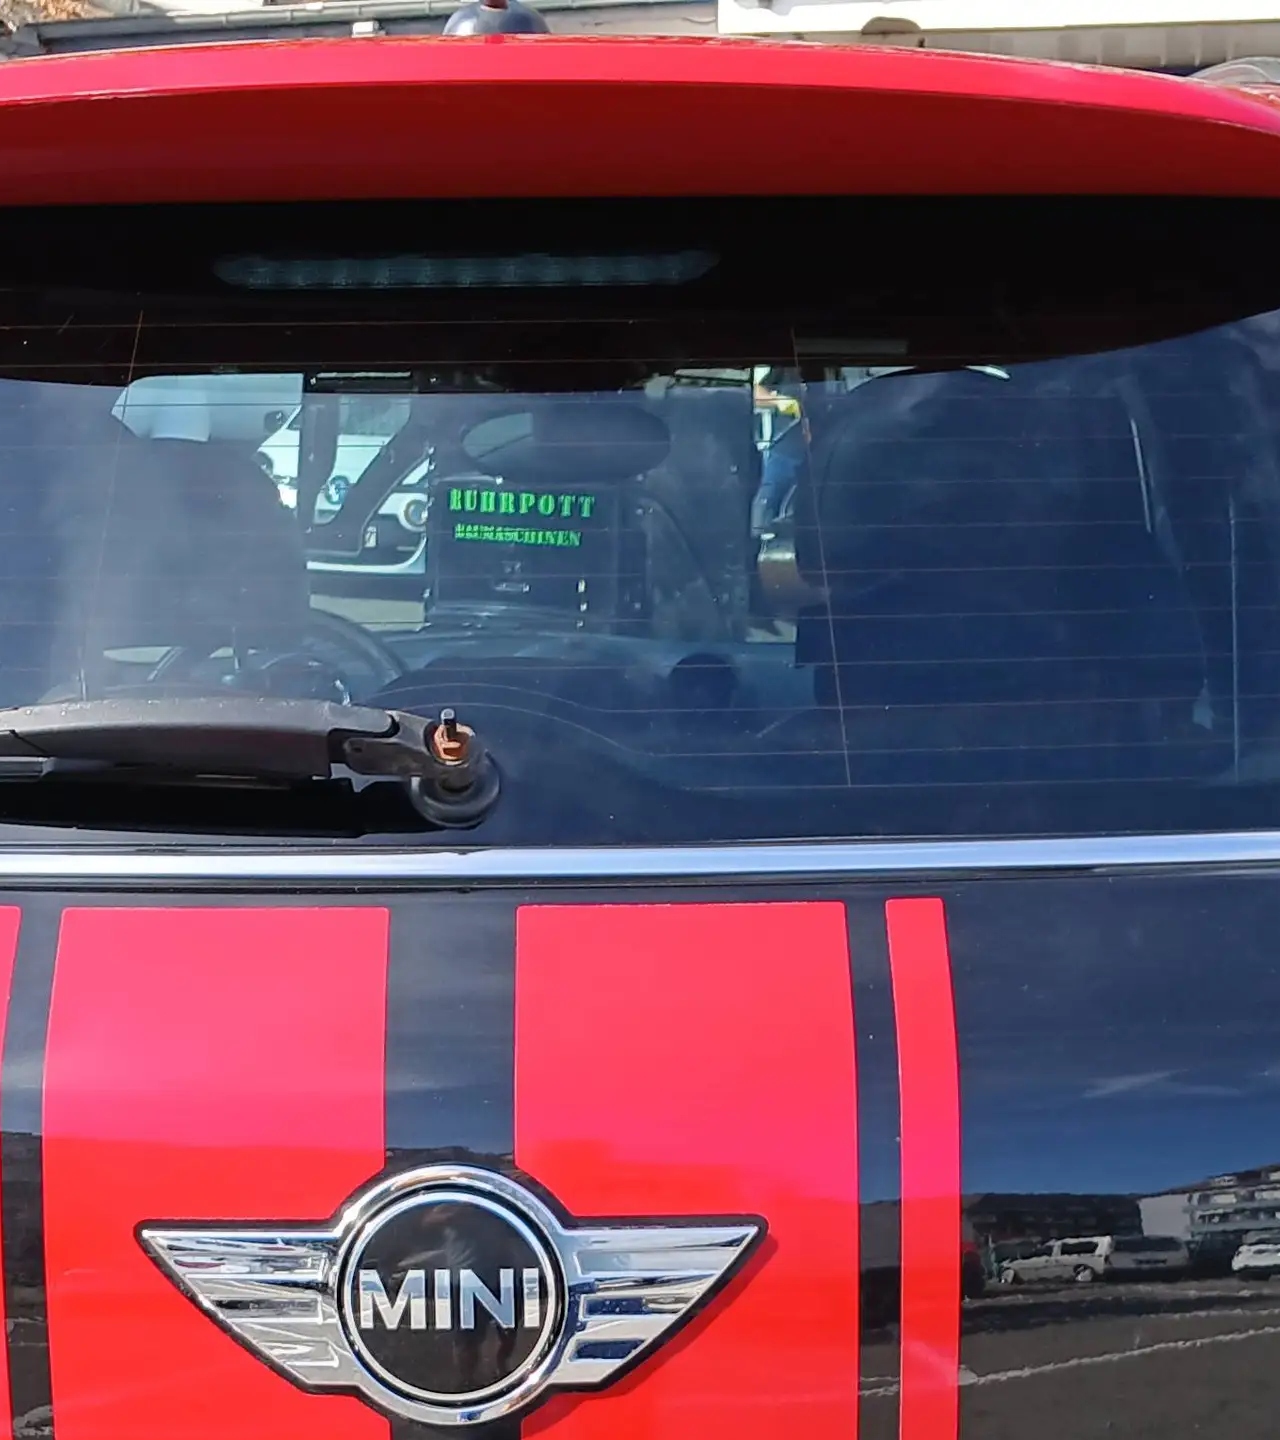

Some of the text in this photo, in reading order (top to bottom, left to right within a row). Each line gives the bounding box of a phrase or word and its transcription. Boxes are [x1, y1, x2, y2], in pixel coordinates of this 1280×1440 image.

[448, 487, 596, 518] RUHRPOTT
[454, 522, 582, 547] BAUMASCHINEN
[358, 1267, 540, 1331] MINI
